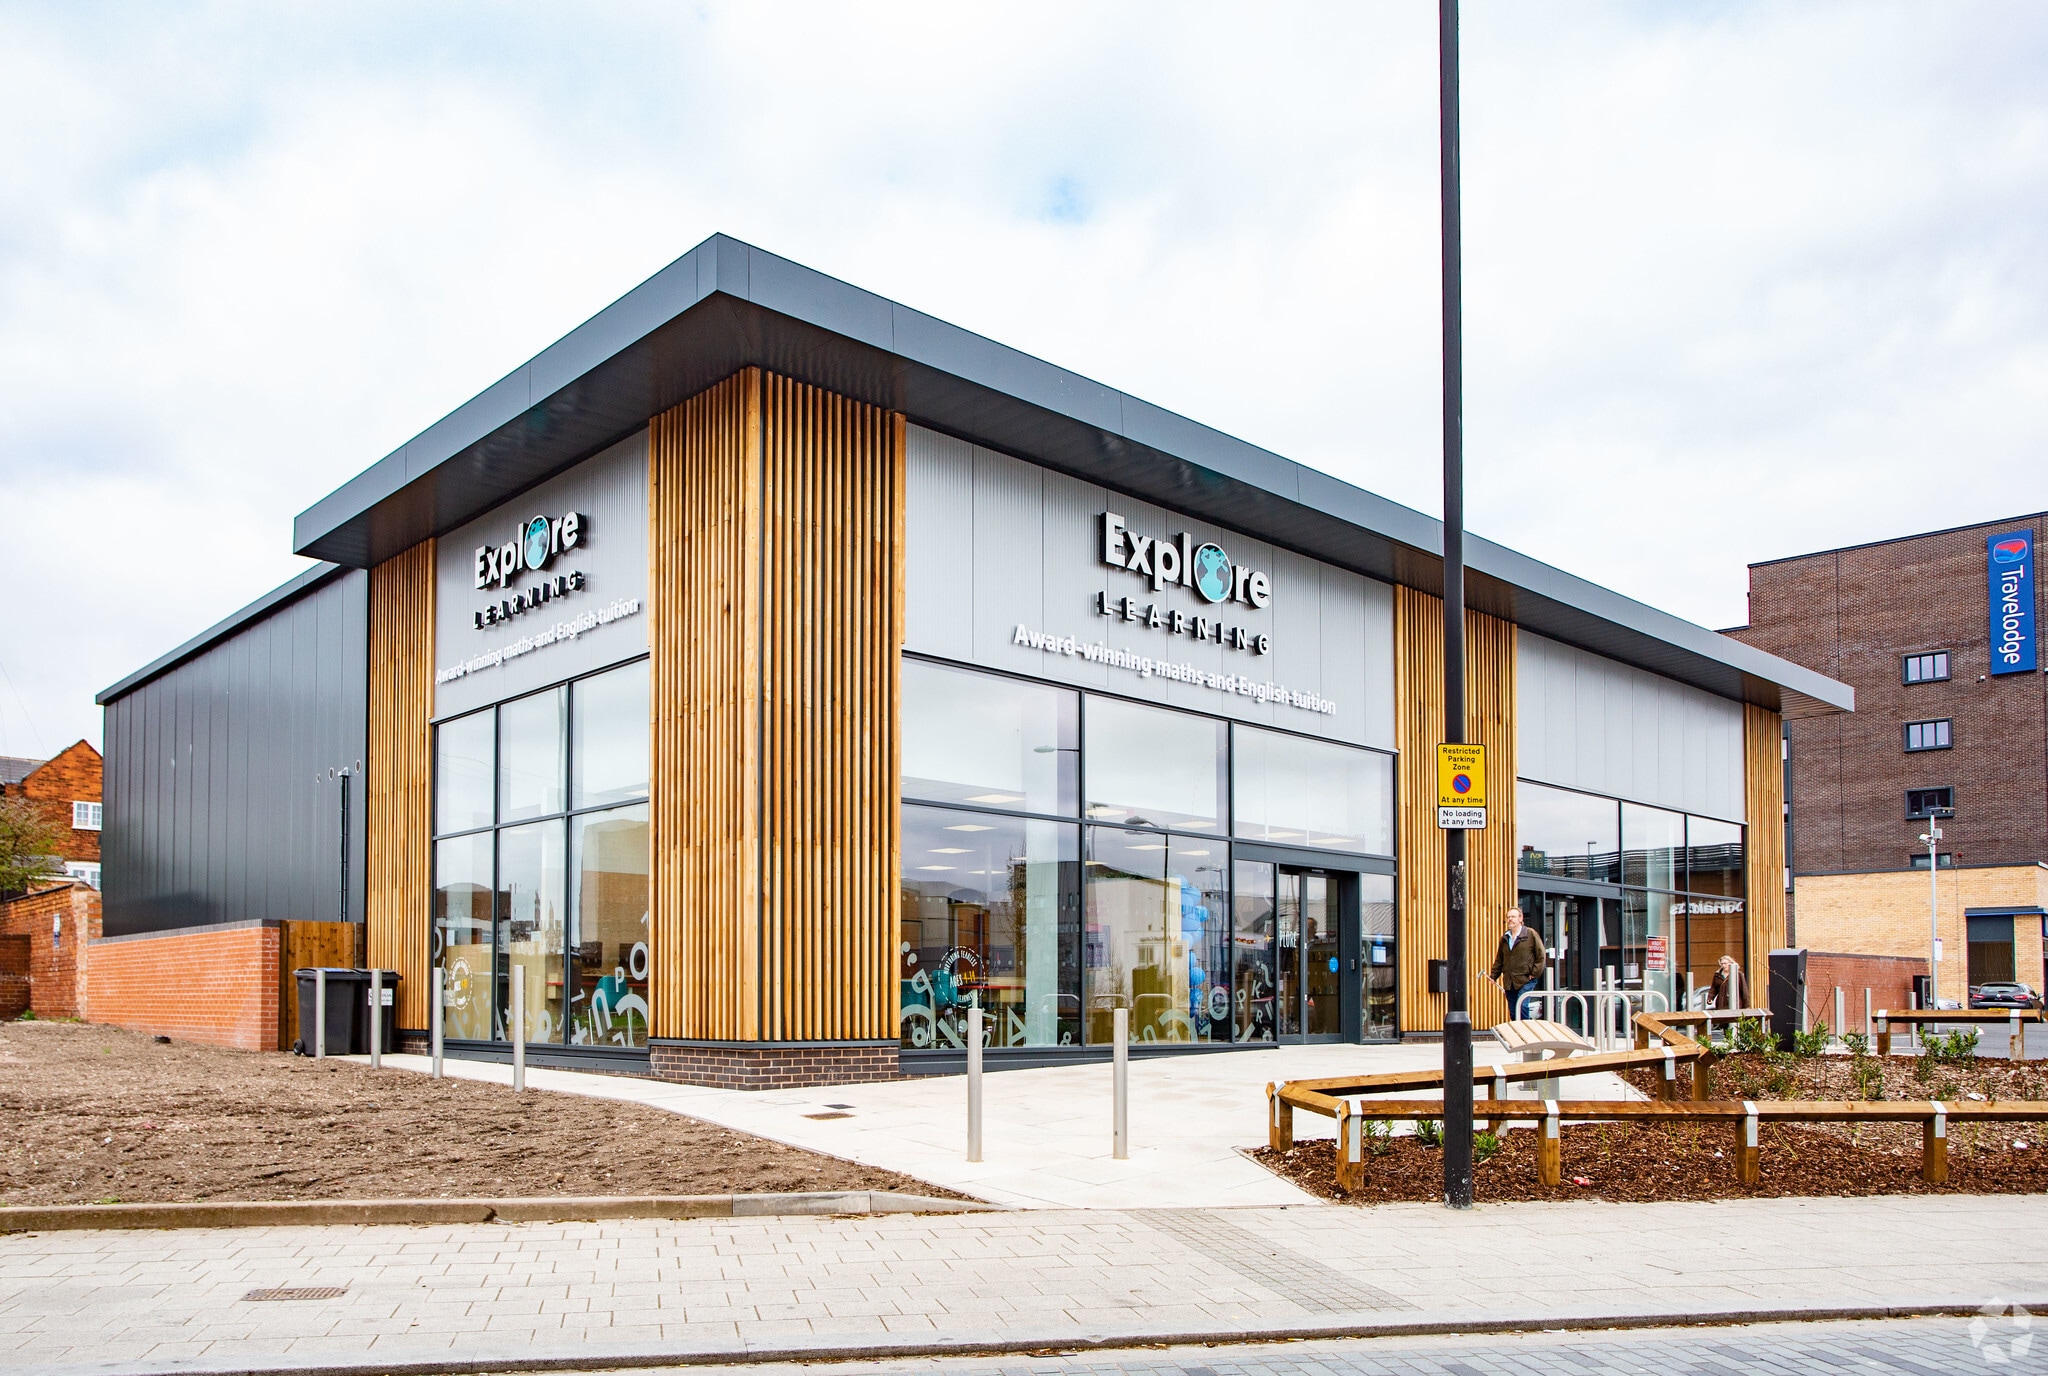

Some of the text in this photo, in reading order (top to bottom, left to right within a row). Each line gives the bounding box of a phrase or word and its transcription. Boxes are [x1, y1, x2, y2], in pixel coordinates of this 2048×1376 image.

[474, 511, 586, 589] Explore
[1101, 511, 1271, 609] Explore
[473, 569, 585, 630] LEARNING
[1098, 590, 1270, 656] LEARNING
[1998, 564, 2026, 665] Travelodge
[435, 598, 640, 685] Award-winning maths and English tuition
[1013, 623, 1337, 715] Award-winning maths and English tuition
[1442, 747, 1480, 755] Restricted
[1447, 755, 1476, 764] Parking
[1452, 763, 1471, 771] Zone
[1455, 810, 1483, 818] loading
[1467, 796, 1484, 804] time
[960, 950, 978, 967] FEARLESS
